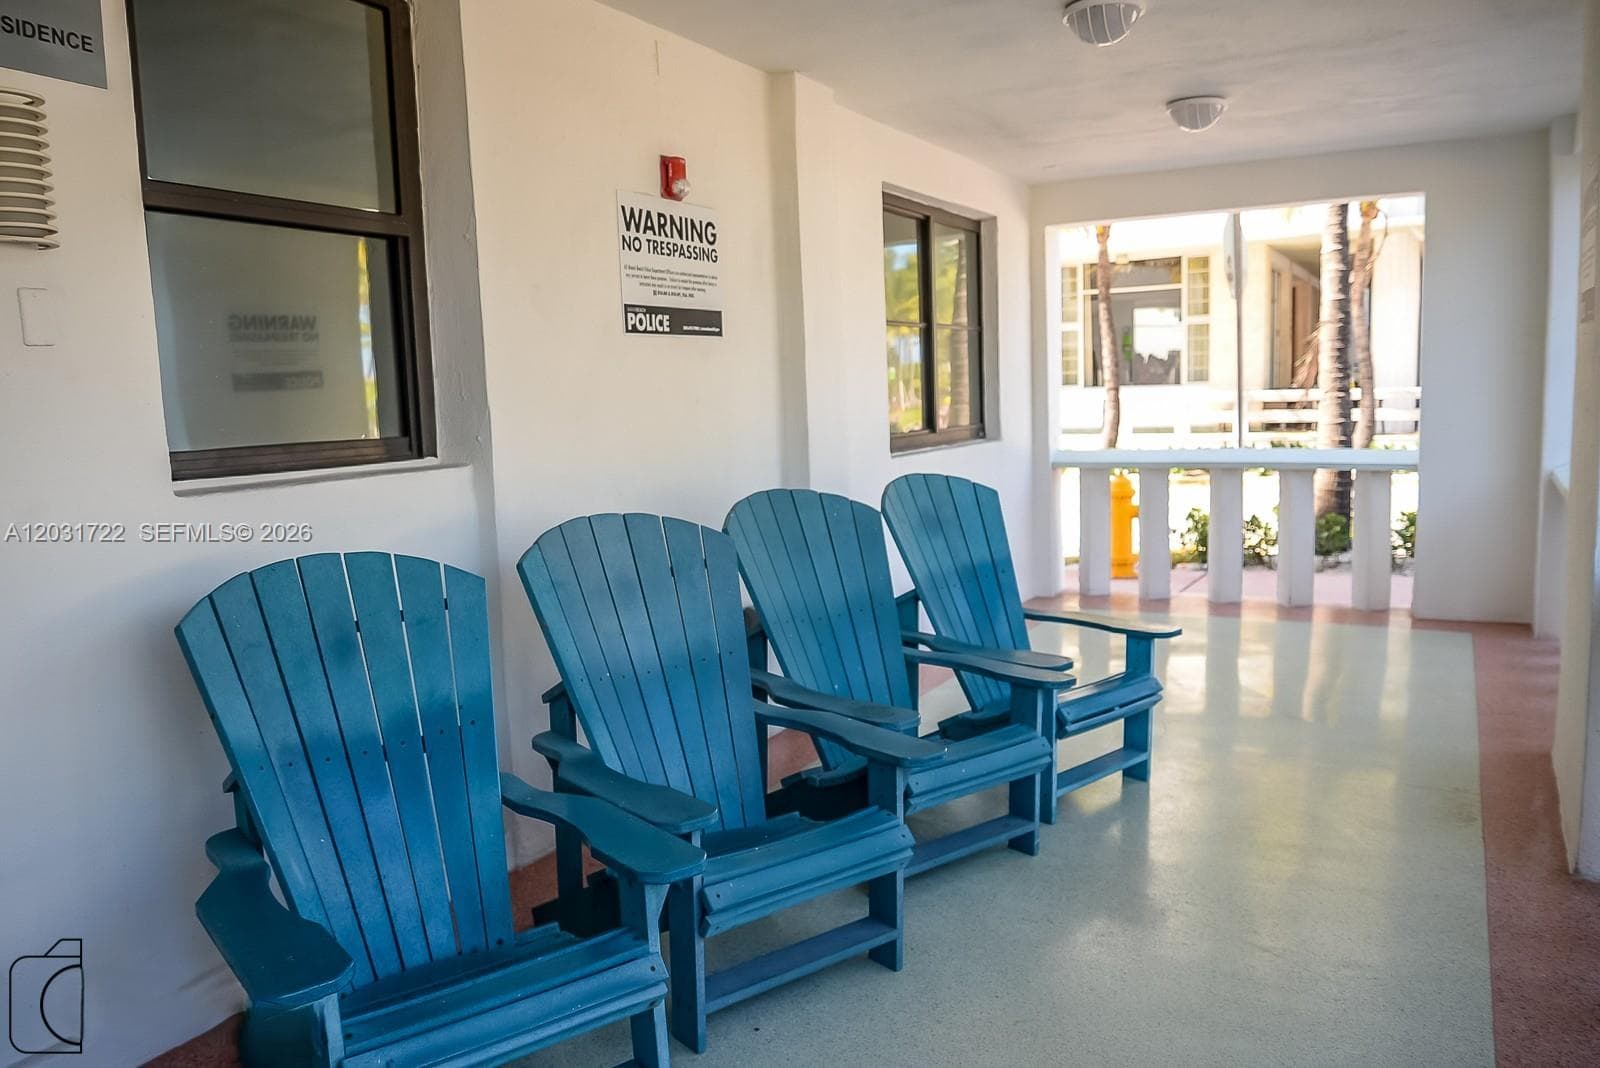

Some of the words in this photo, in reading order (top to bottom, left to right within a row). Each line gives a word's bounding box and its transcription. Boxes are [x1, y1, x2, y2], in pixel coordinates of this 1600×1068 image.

[0, 15, 94, 53] SIDENCE
[621, 205, 717, 246] WARNING
[622, 234, 642, 253] NO
[646, 238, 718, 263] TRESPASSING
[627, 312, 670, 332] POLICE
